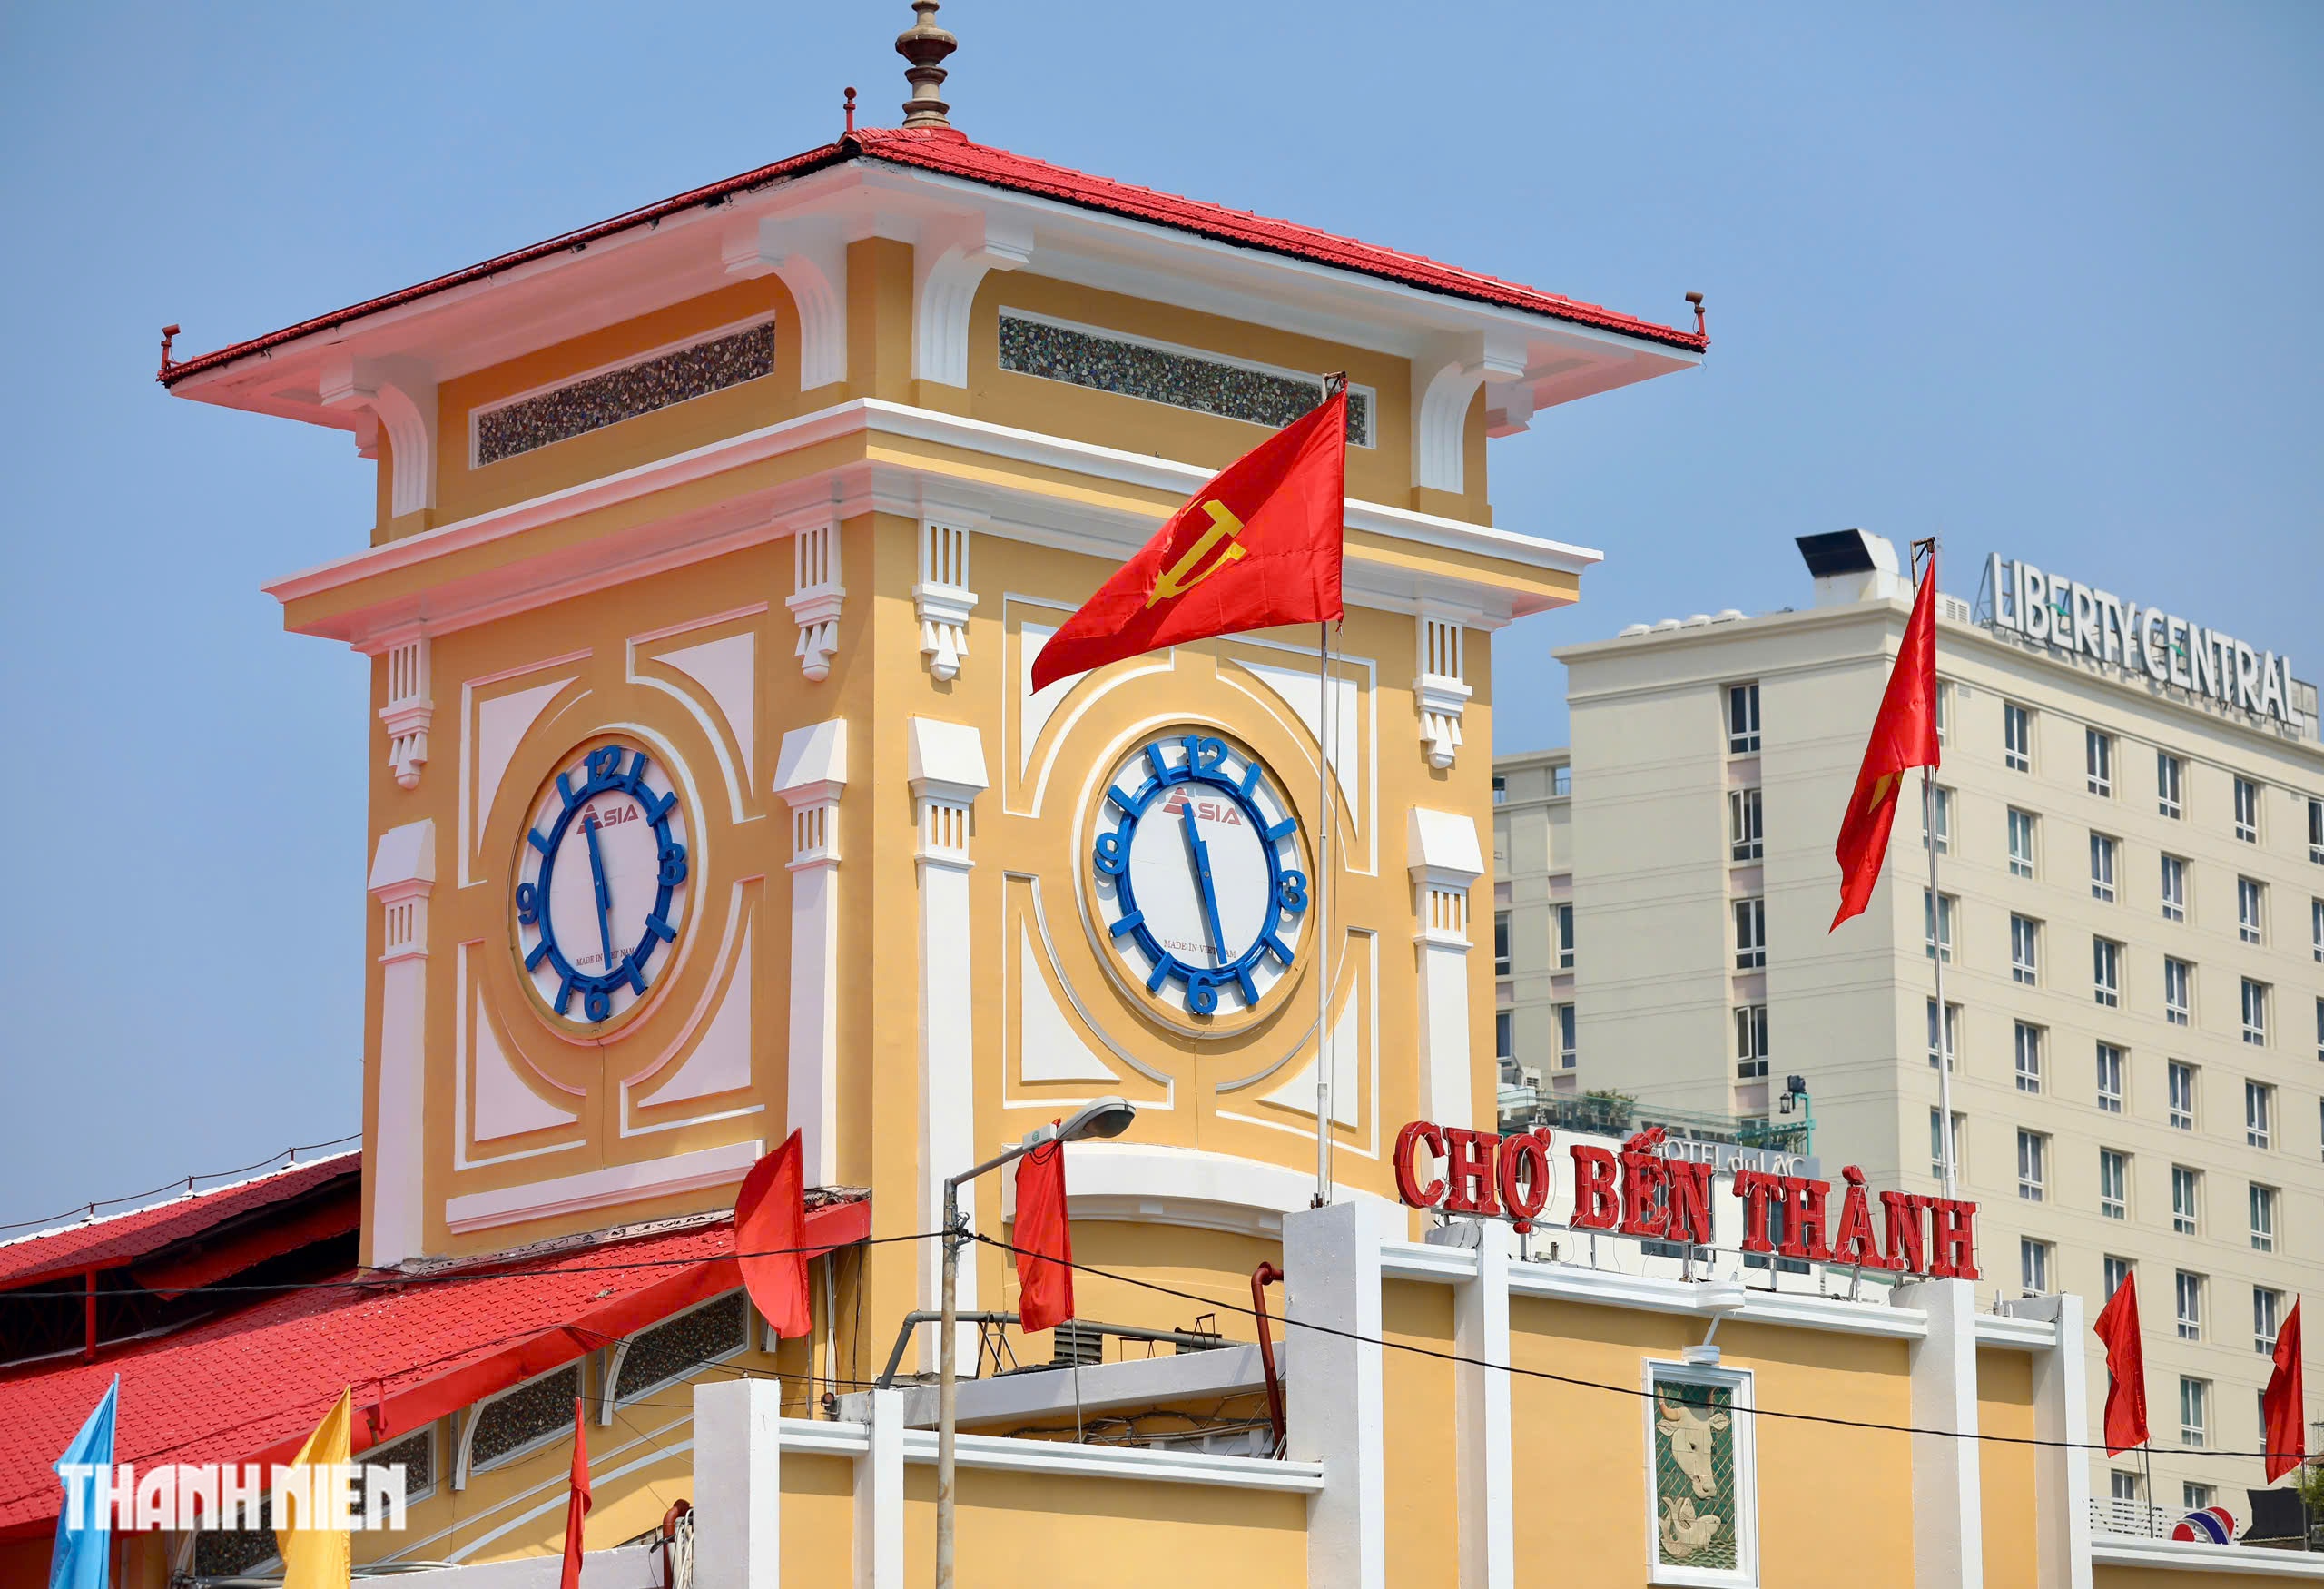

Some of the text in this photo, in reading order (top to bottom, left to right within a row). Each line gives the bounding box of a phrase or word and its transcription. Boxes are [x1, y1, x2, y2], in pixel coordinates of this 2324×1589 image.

[1988, 552, 2303, 726] LIBERTY CENTRAL
[584, 745, 624, 793] 12
[1181, 734, 1227, 783] 12
[657, 842, 688, 887] 3
[1095, 831, 1125, 875] 9
[515, 882, 539, 926] 9
[1279, 869, 1309, 913] 3
[576, 955, 595, 966] MADE
[596, 953, 604, 962] IN
[1164, 939, 1187, 951] MADE
[1188, 943, 1198, 952] IN
[585, 977, 611, 1022] 6
[1187, 971, 1219, 1015] 6
[1393, 1120, 1980, 1279] CHỢ BẾN THÀNH
